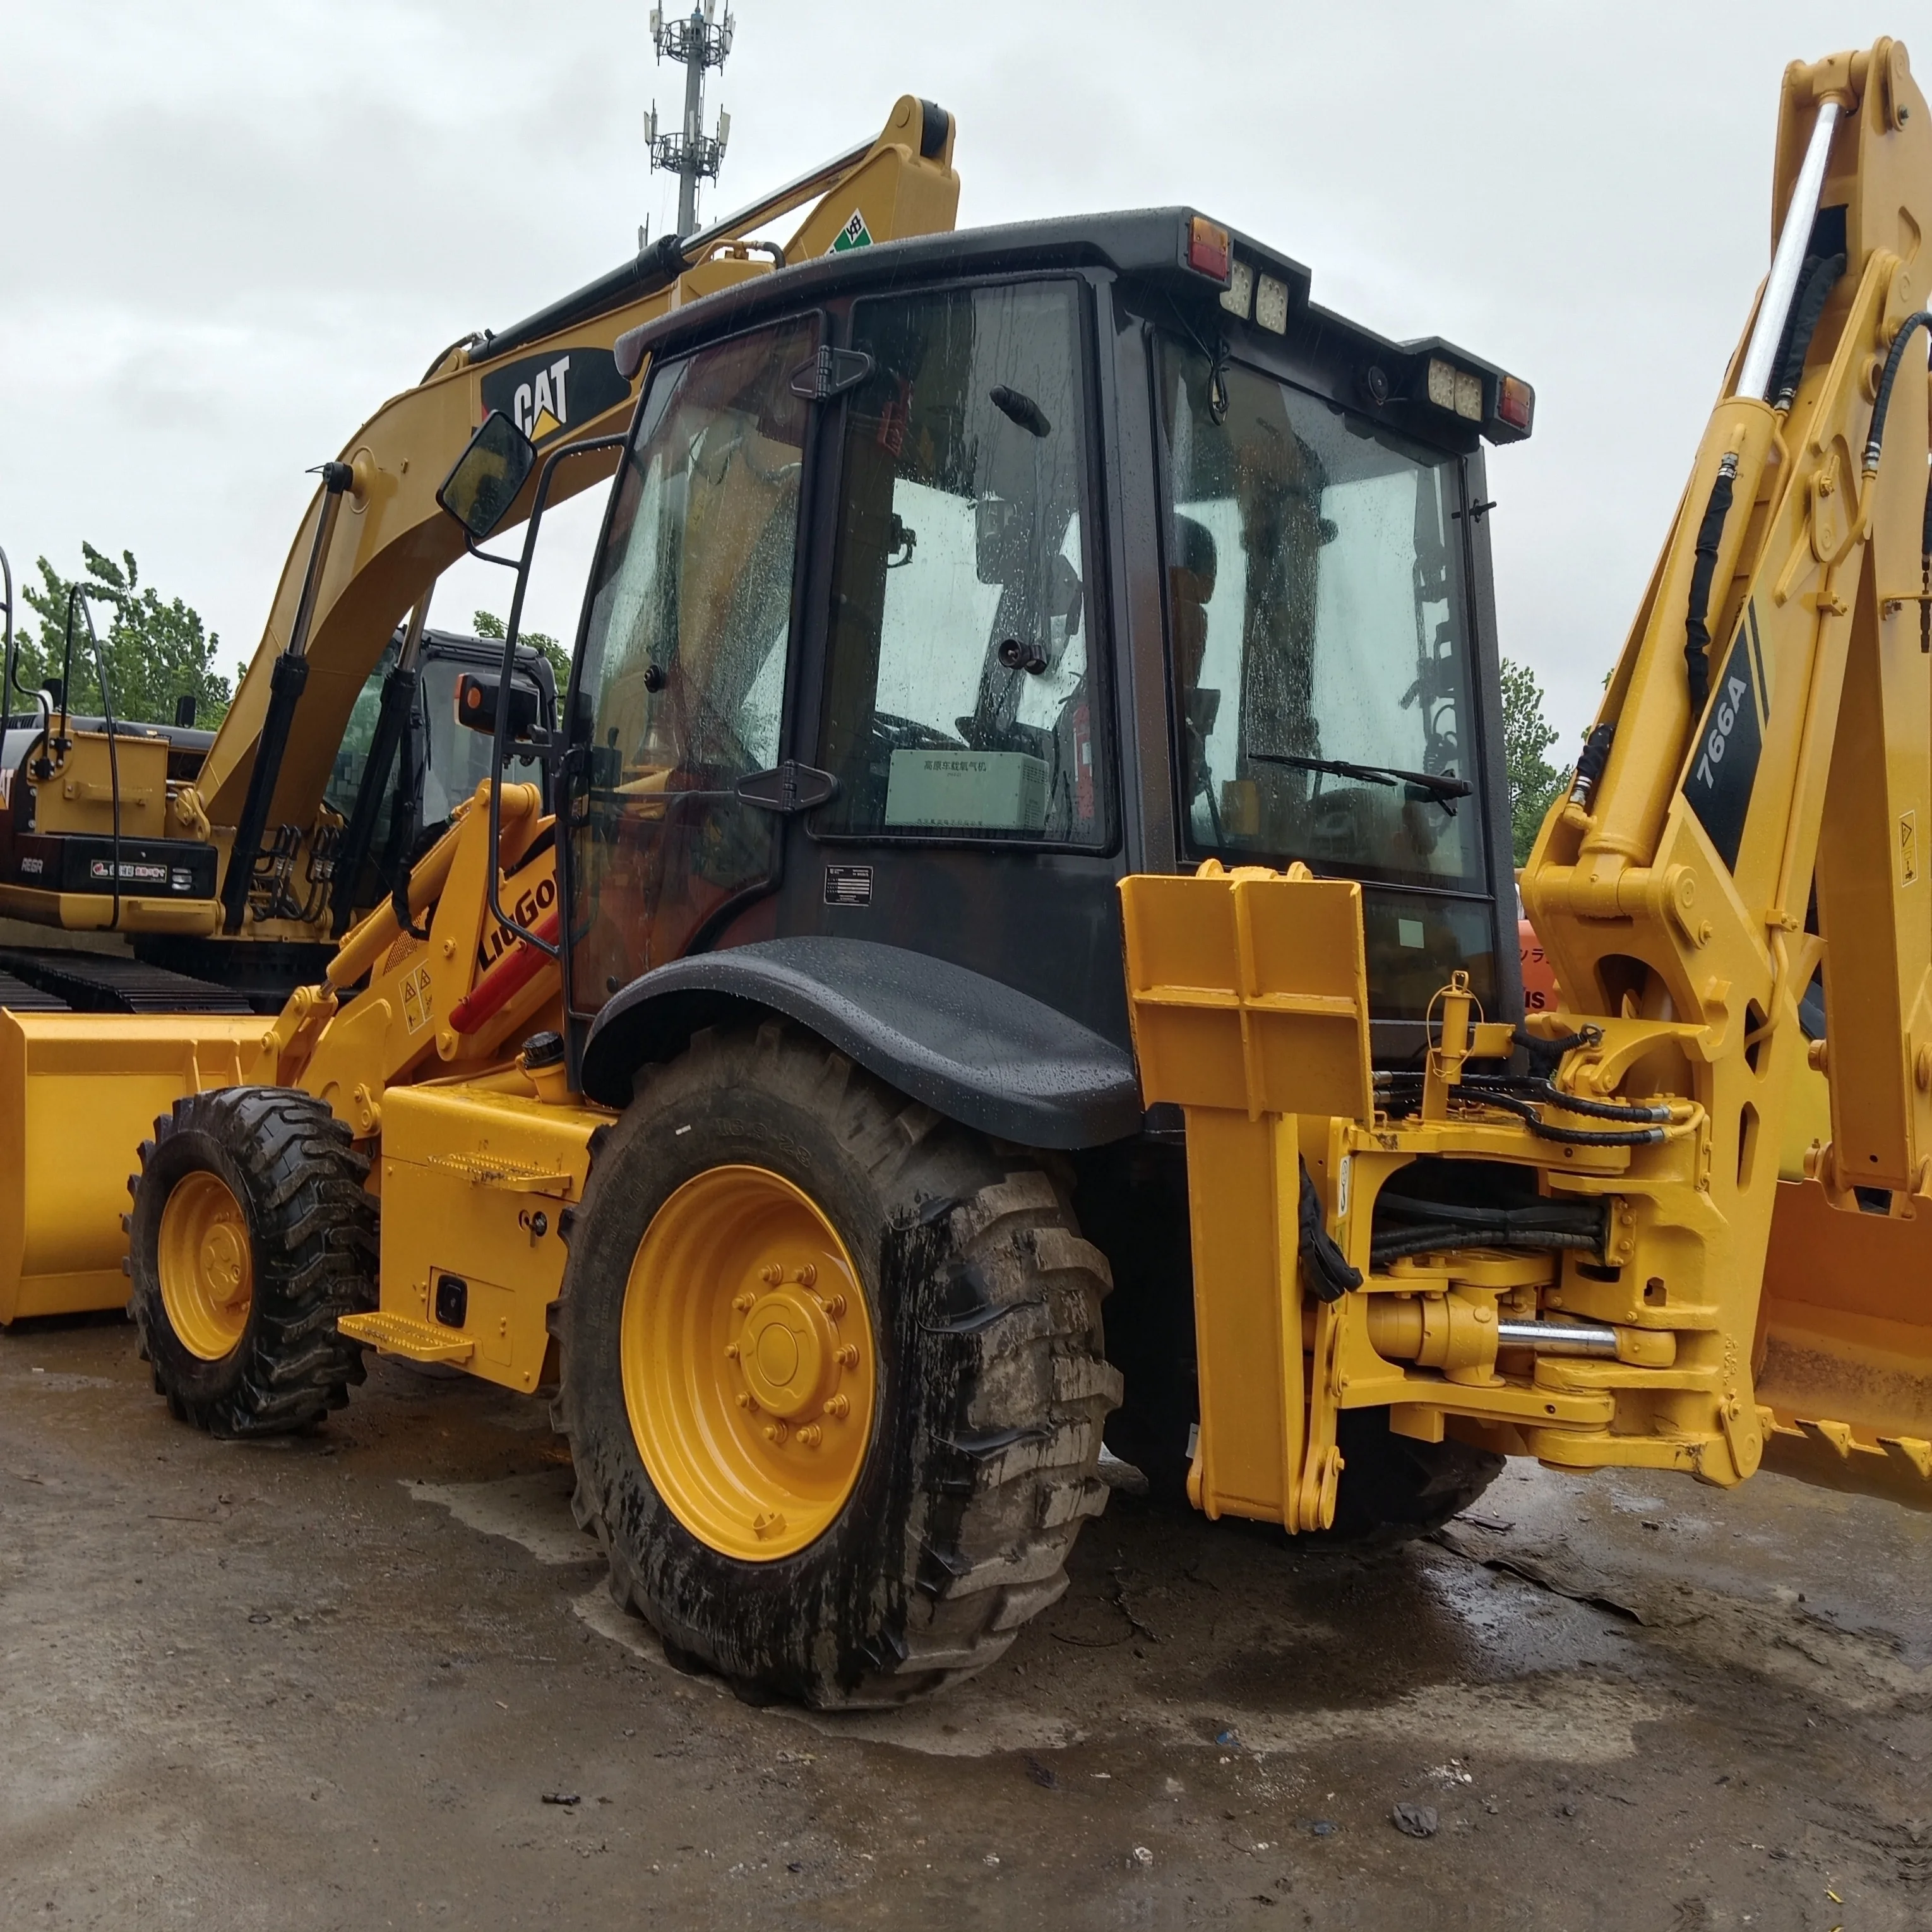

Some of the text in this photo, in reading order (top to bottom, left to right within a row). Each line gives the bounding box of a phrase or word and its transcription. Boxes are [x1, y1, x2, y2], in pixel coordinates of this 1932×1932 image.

[514, 355, 569, 439] CAT
[1696, 676, 1747, 789] 766A
[0, 768, 15, 811] AT
[1523, 987, 1545, 1009] IS
